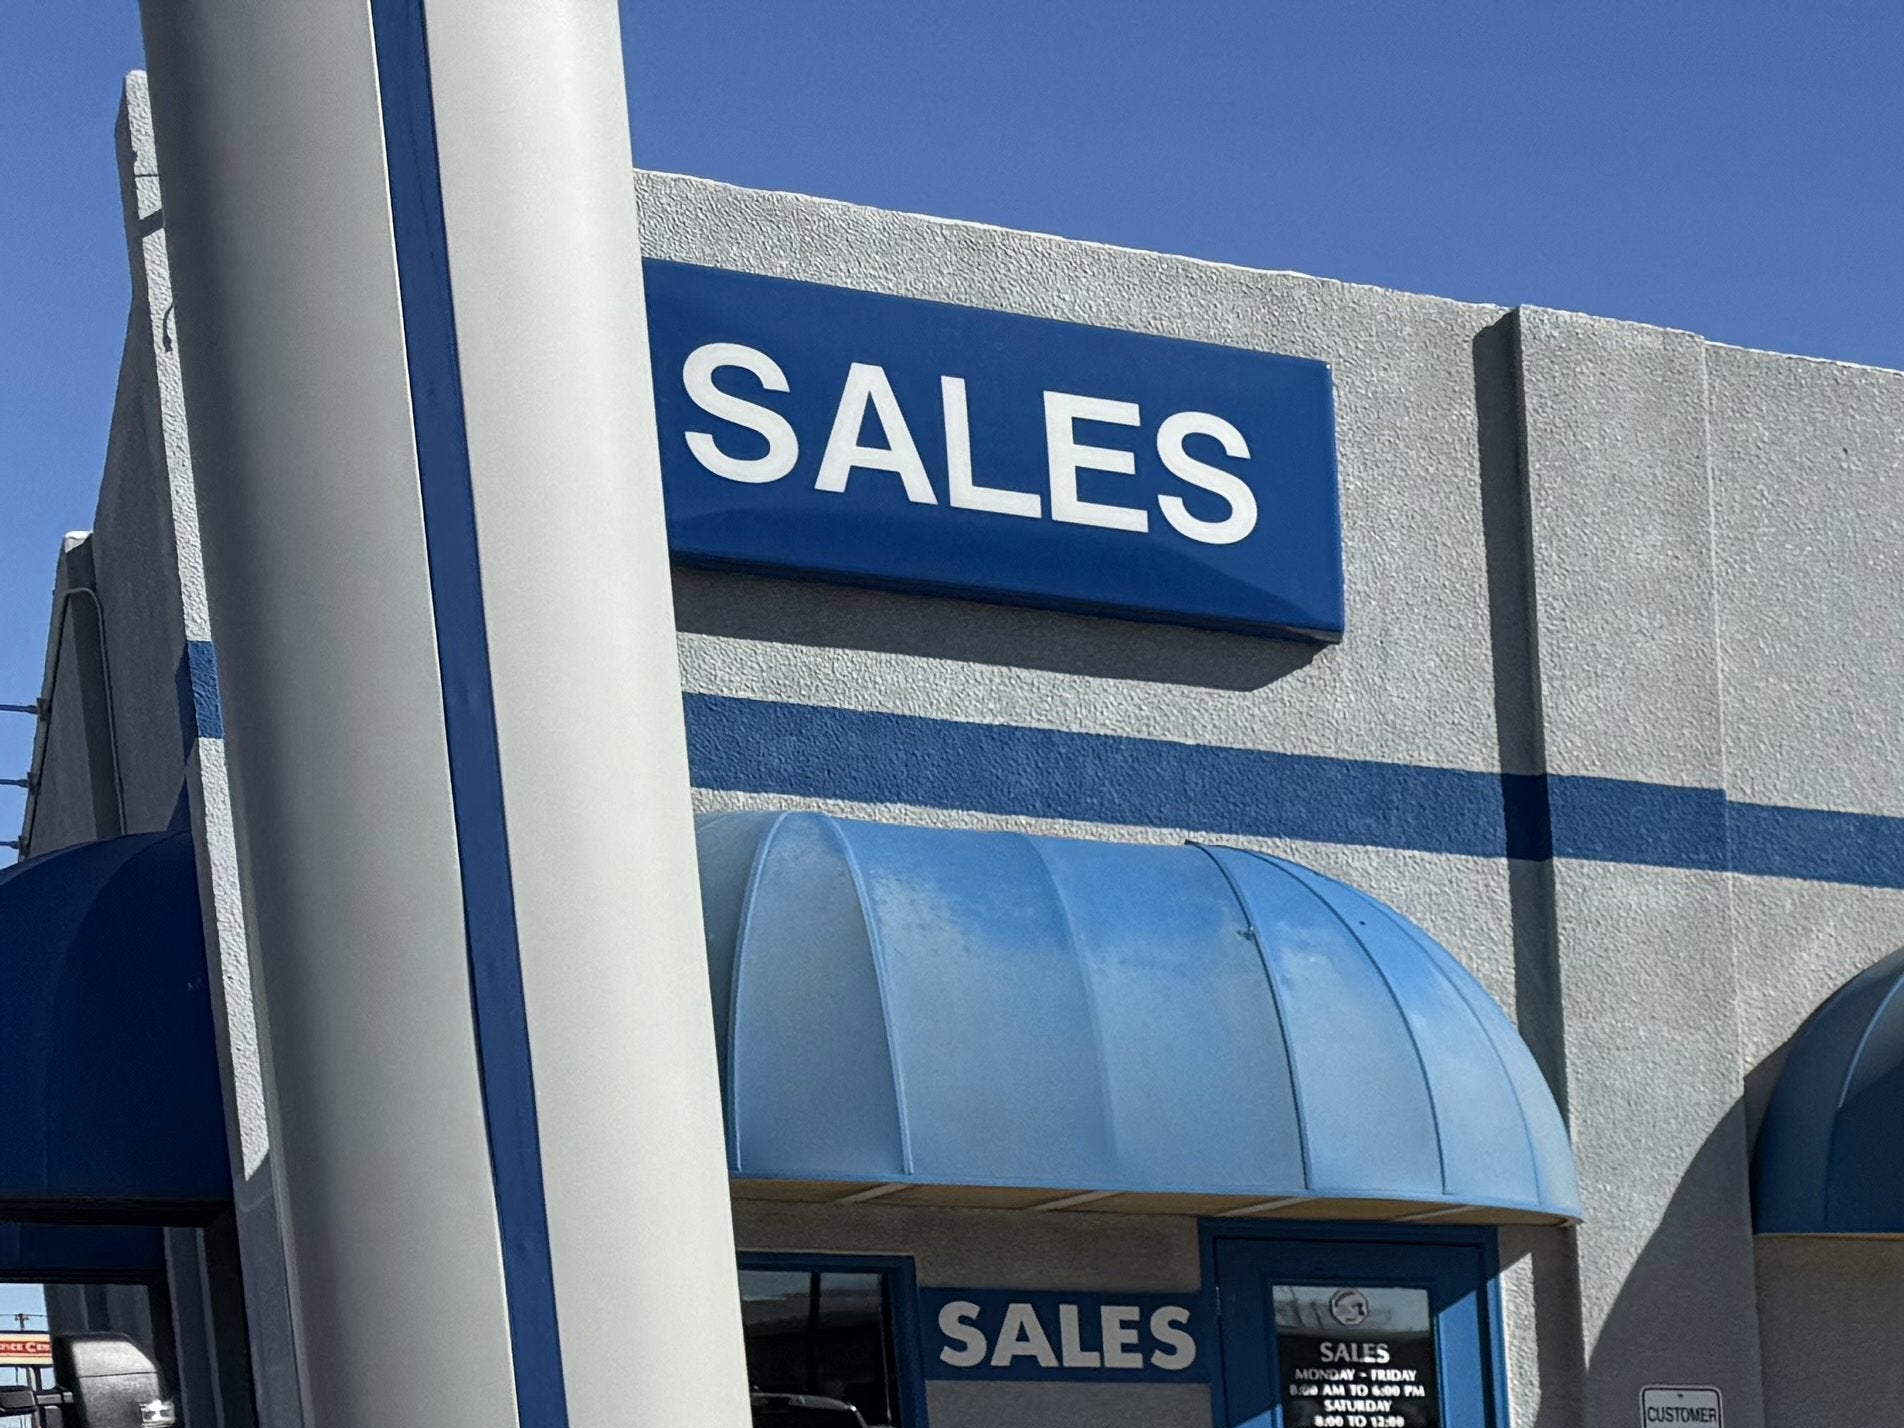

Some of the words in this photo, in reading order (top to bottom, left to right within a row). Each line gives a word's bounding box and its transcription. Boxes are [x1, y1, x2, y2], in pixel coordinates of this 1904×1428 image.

[682, 341, 1259, 546] SALES
[937, 1300, 1197, 1371] SALES
[1320, 1341, 1390, 1363] SALES
[1295, 1368, 1356, 1381] MONDAY
[1371, 1369, 1416, 1381] FRIDAY
[1322, 1384, 1346, 1396] AM
[1349, 1384, 1368, 1396] TO
[1371, 1384, 1401, 1397] 6:00
[1403, 1385, 1426, 1397] PM
[1323, 1399, 1393, 1412] SATURDAY
[1347, 1415, 1367, 1427] TO
[1647, 1406, 1717, 1423] CUSTOMER
